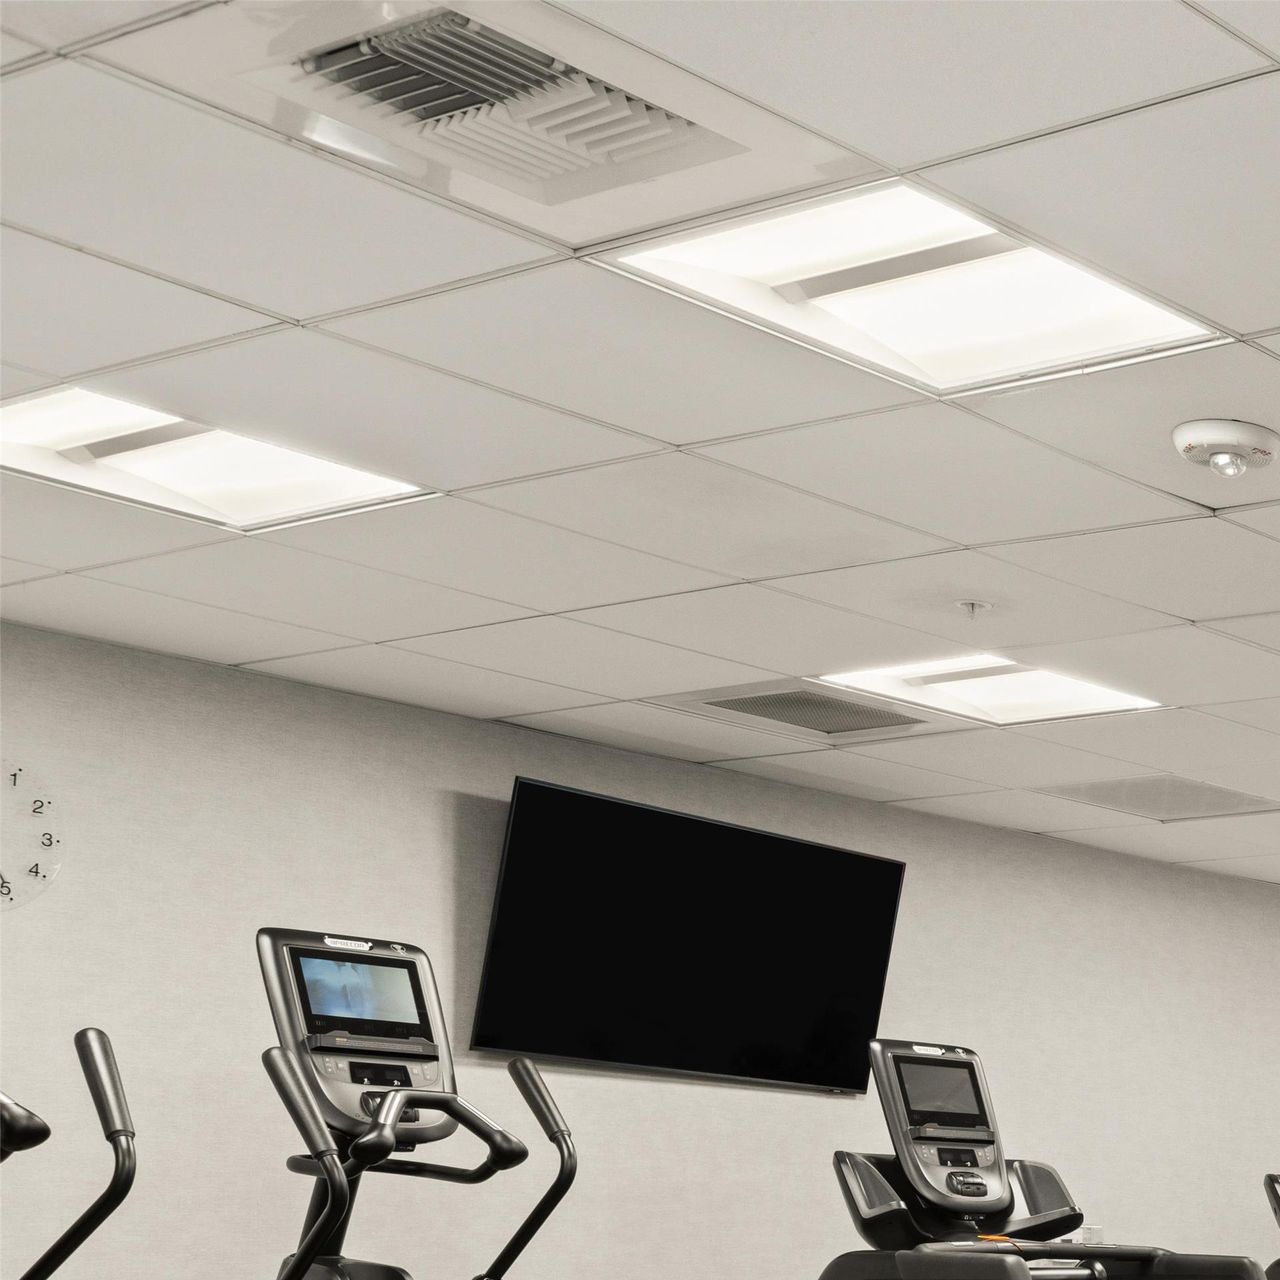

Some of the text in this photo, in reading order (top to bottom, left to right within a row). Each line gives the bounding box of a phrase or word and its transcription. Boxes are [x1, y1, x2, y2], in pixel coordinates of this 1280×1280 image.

[10, 773, 17, 787] 1
[32, 799, 44, 814] 2
[41, 832, 53, 847] 3
[28, 863, 40, 877] 4
[0, 880, 11, 896] 5
